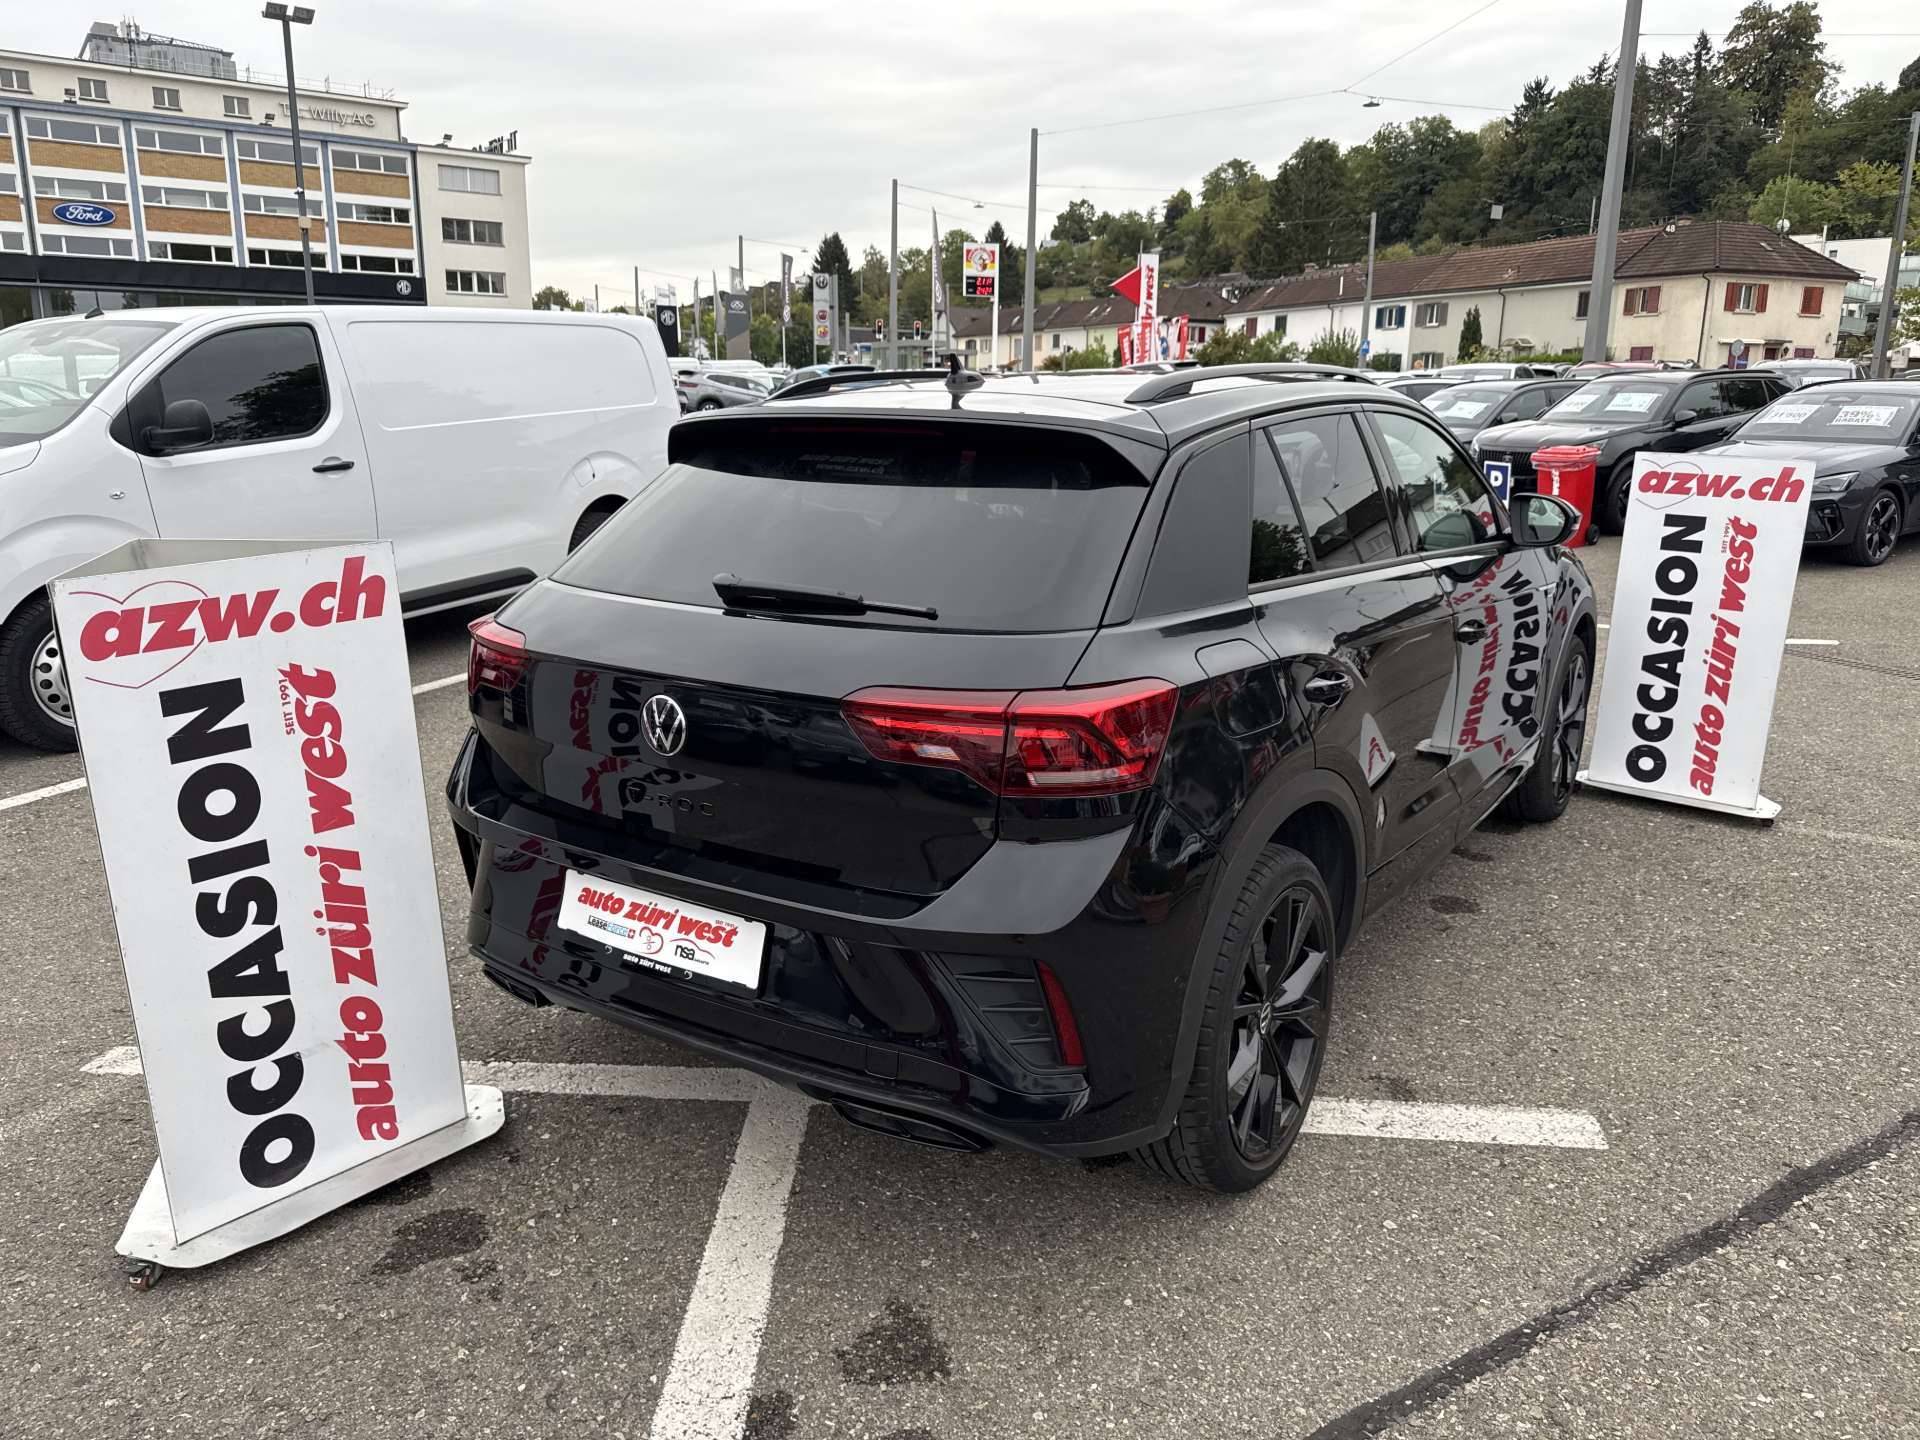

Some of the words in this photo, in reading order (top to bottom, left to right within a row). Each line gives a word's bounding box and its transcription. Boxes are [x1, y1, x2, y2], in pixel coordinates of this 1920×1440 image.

[309, 105, 347, 127] Willy
[352, 111, 376, 129] AG
[65, 205, 104, 222] Ford
[396, 279, 412, 296] MG
[660, 310, 677, 327] MG
[1637, 466, 1805, 503] azw.ch
[1718, 515, 1758, 613] west
[79, 555, 387, 662] azw.ch
[1625, 513, 1707, 783] OCCASION
[1702, 613, 1741, 706] züri
[279, 678, 291, 707] 1991
[284, 711, 296, 736] SEIT
[277, 661, 355, 834] west
[1690, 704, 1725, 796] auto
[159, 677, 316, 1189] OCCASION
[303, 845, 378, 988] züri
[577, 886, 625, 915] auto
[623, 901, 680, 930] züri
[677, 915, 739, 948] west
[622, 952, 639, 964] auto
[638, 957, 655, 970] züri
[654, 963, 672, 975] west
[674, 944, 696, 961] nsa
[334, 995, 400, 1142] auto
